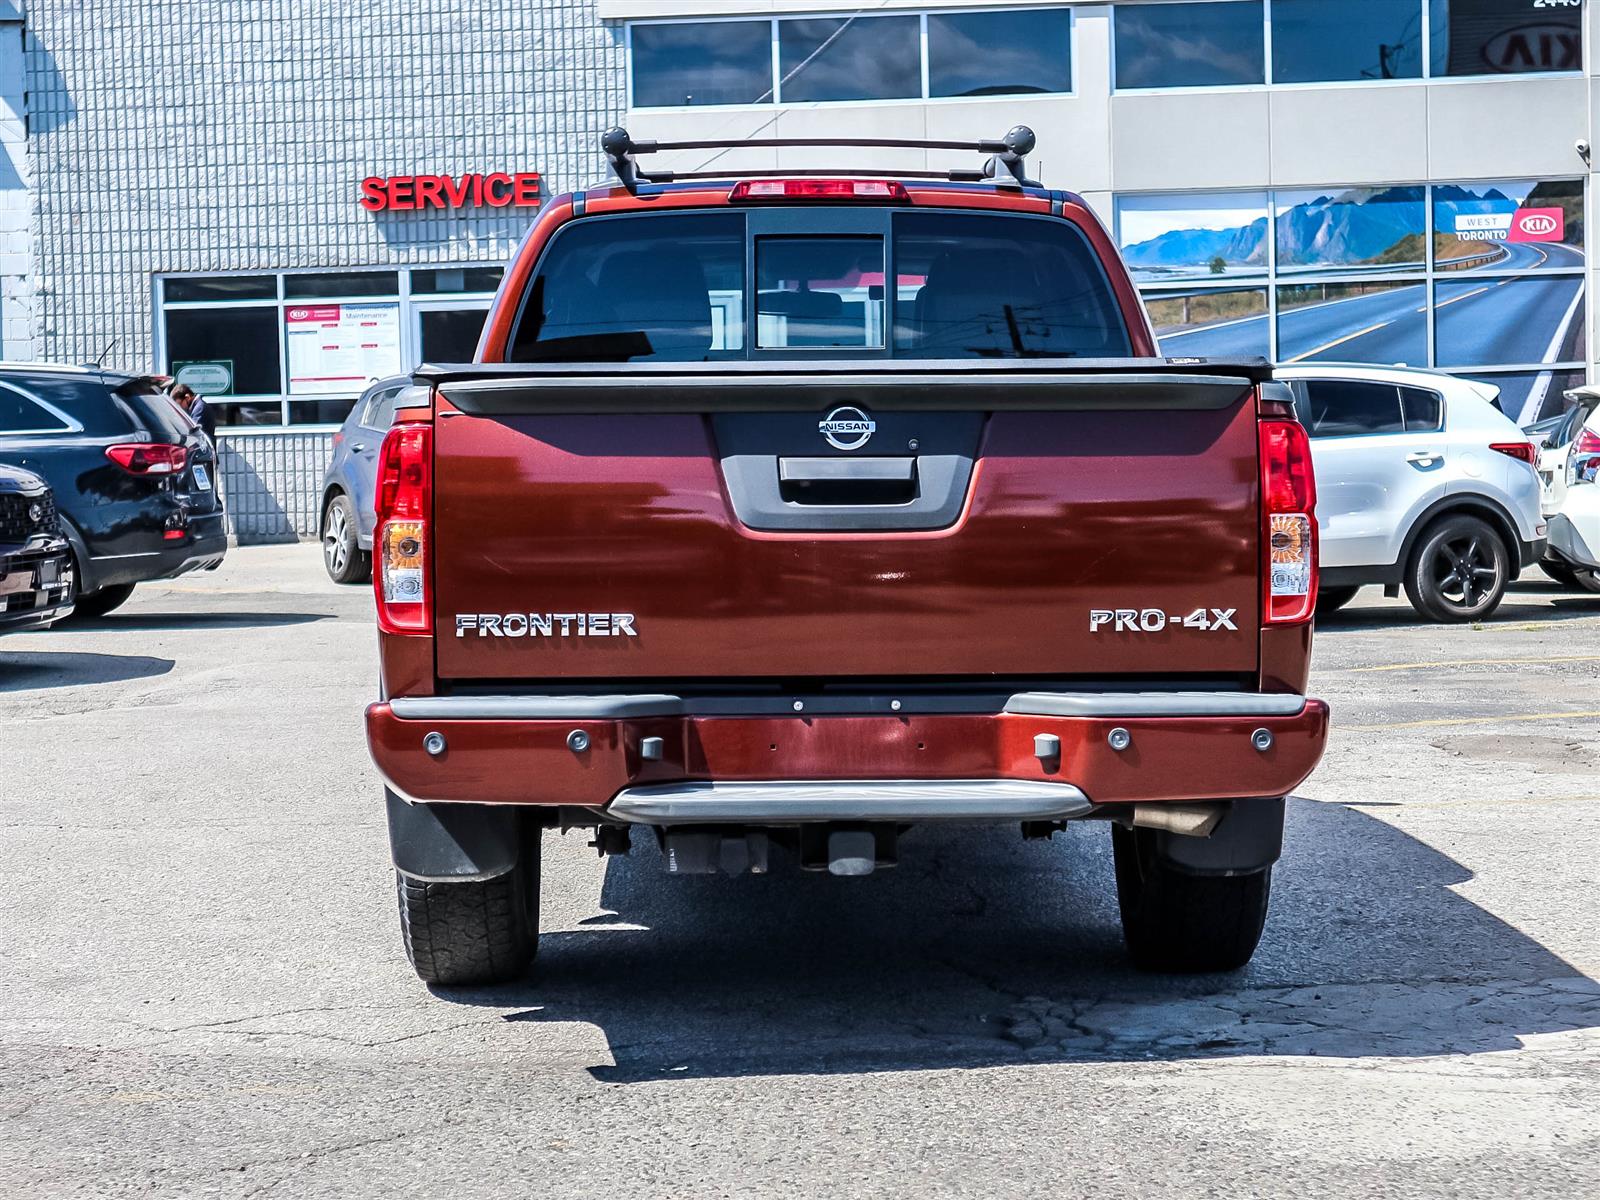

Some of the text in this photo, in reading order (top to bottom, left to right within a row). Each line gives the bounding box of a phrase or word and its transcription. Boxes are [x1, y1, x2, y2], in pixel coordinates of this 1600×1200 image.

[360, 172, 541, 212] SERVICE
[1466, 217, 1498, 227] WEST
[1456, 230, 1507, 241] TORONTO
[825, 422, 870, 431] NISSAN
[455, 612, 638, 637] FRONTIER
[1089, 608, 1239, 632] PRO-4X
